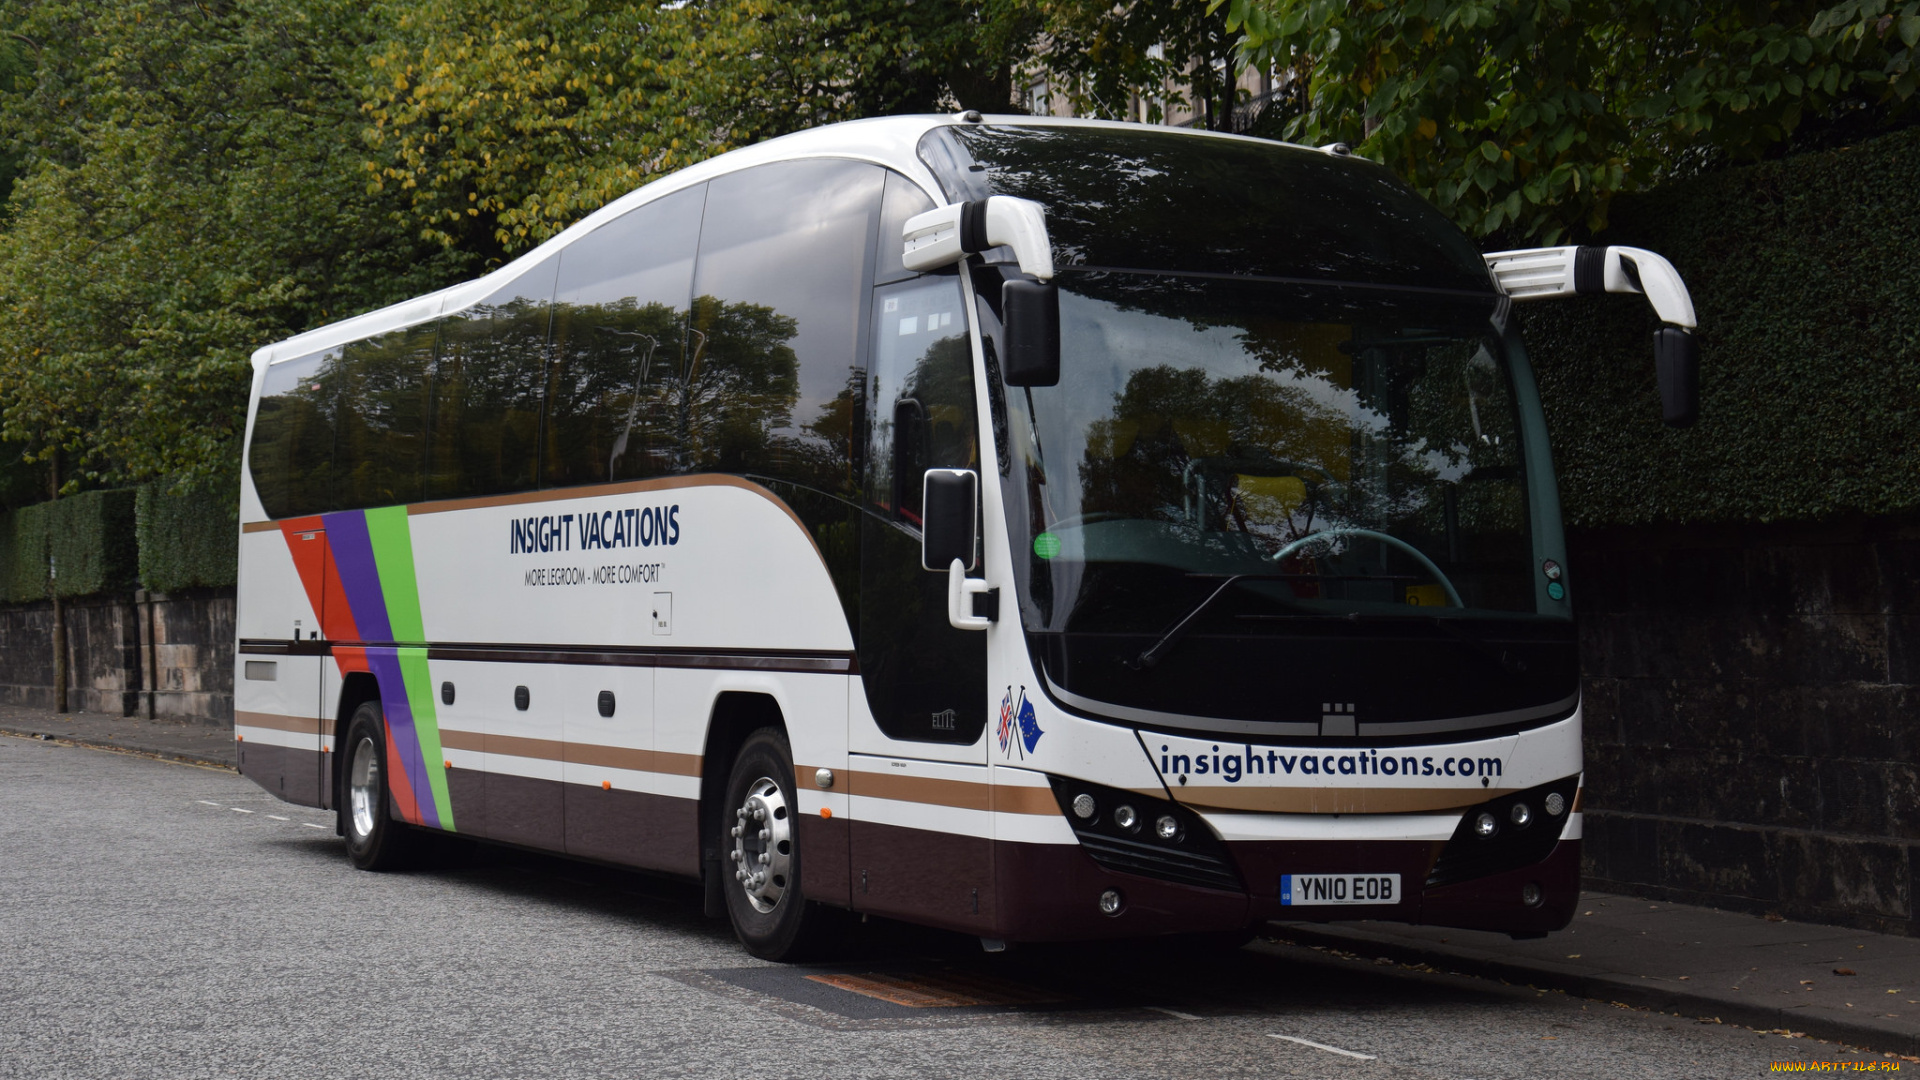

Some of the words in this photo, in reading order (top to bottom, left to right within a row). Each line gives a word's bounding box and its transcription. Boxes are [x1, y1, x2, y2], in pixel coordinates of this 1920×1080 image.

[510, 514, 574, 554] INSIGHT
[578, 504, 680, 550] VACATIONS
[524, 568, 546, 586] MORE
[547, 567, 586, 585] LEGROOM
[592, 565, 616, 584] MORE
[931, 710, 955, 730] ELITE
[1161, 744, 1502, 782] insightvacations.com
[1300, 877, 1347, 900] YN10
[1353, 877, 1392, 900] EOB
